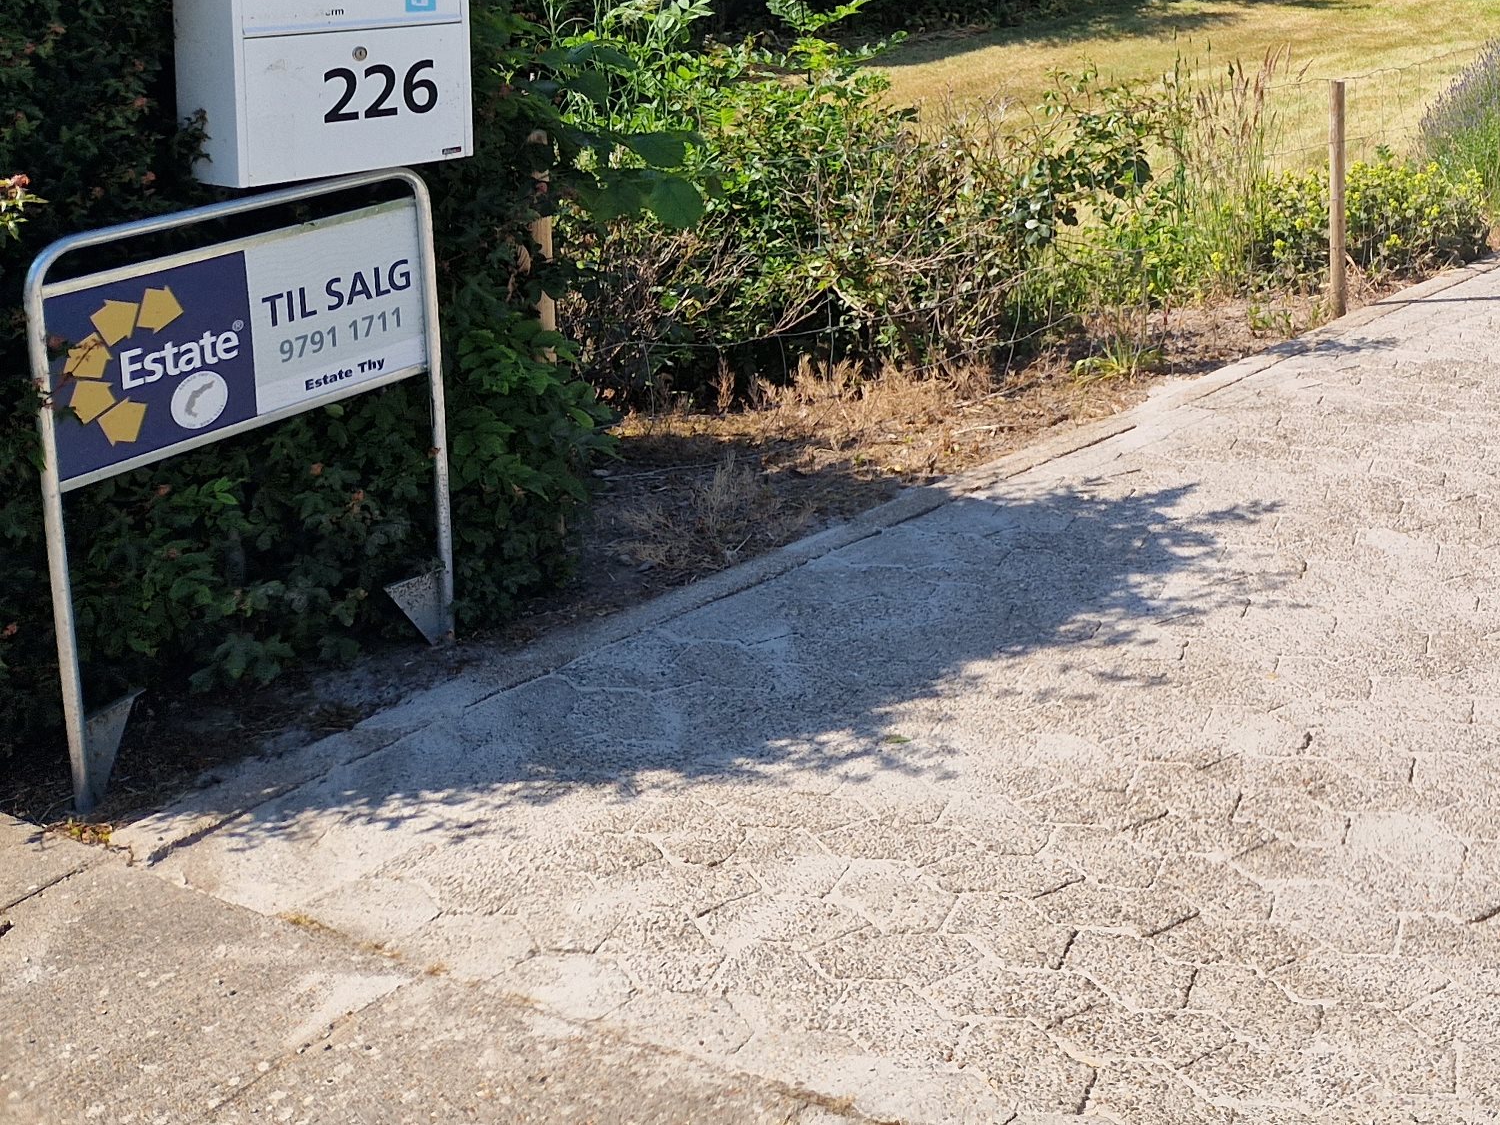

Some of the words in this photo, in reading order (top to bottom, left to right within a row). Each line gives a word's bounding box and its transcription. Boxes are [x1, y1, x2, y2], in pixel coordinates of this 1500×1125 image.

[323, 59, 438, 124] 226
[261, 287, 318, 327] TIL
[325, 259, 411, 311] SALG
[279, 326, 337, 363] 9791
[348, 306, 402, 341] 1711
[305, 369, 353, 391] Estate
[357, 358, 385, 374] Thy
